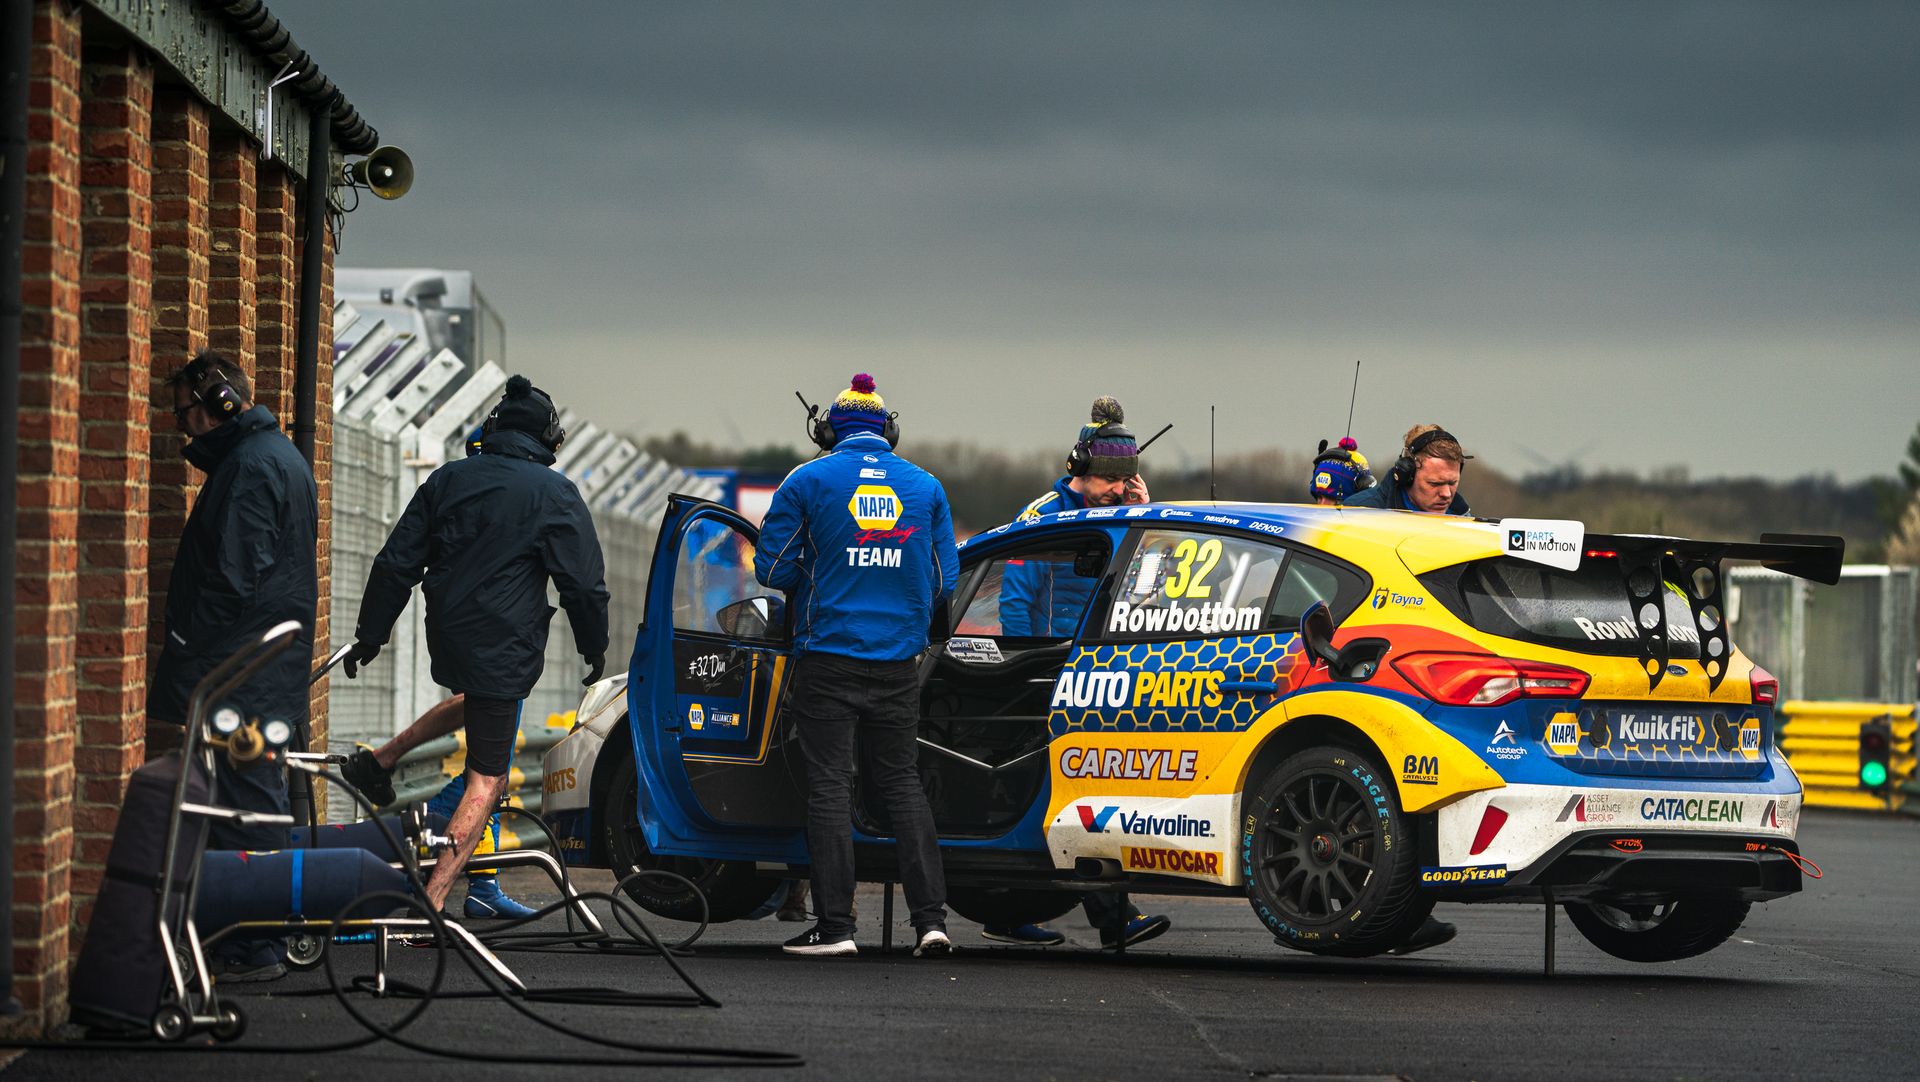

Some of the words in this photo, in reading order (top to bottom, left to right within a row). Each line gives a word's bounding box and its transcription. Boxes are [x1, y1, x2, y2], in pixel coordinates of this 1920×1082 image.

[859, 496, 895, 518] NAPA
[1203, 515, 1239, 525] nexdrive
[1249, 521, 1284, 534] DENSO
[854, 523, 921, 545] Racing
[1527, 531, 1554, 541] PARTS
[1526, 541, 1535, 551] IN
[1538, 541, 1576, 552] MOTION
[846, 547, 902, 568] TEAM
[1164, 539, 1223, 599] 32
[1391, 593, 1424, 606] Tayna
[1109, 601, 1262, 634] Rowbottom
[1052, 671, 1130, 708] AUTO
[1132, 670, 1226, 708] PARTS
[711, 713, 733, 723] ALLIANCE
[1551, 724, 1577, 744] NAPA
[1742, 730, 1758, 749] NAPA
[1486, 746, 1528, 755] Autotech
[1060, 747, 1199, 781] CARLYLE
[1403, 755, 1438, 775] BM
[1352, 767, 1390, 818] EAGLE
[1586, 794, 1610, 802] ASSET
[1586, 803, 1622, 813] ALLIANCE
[1586, 813, 1614, 822] GROUP
[1640, 797, 1743, 823] CATACLEAN
[1120, 812, 1211, 837] Valvoline
[1745, 842, 1760, 851] TOW
[1130, 847, 1217, 874] AUTOCAR
